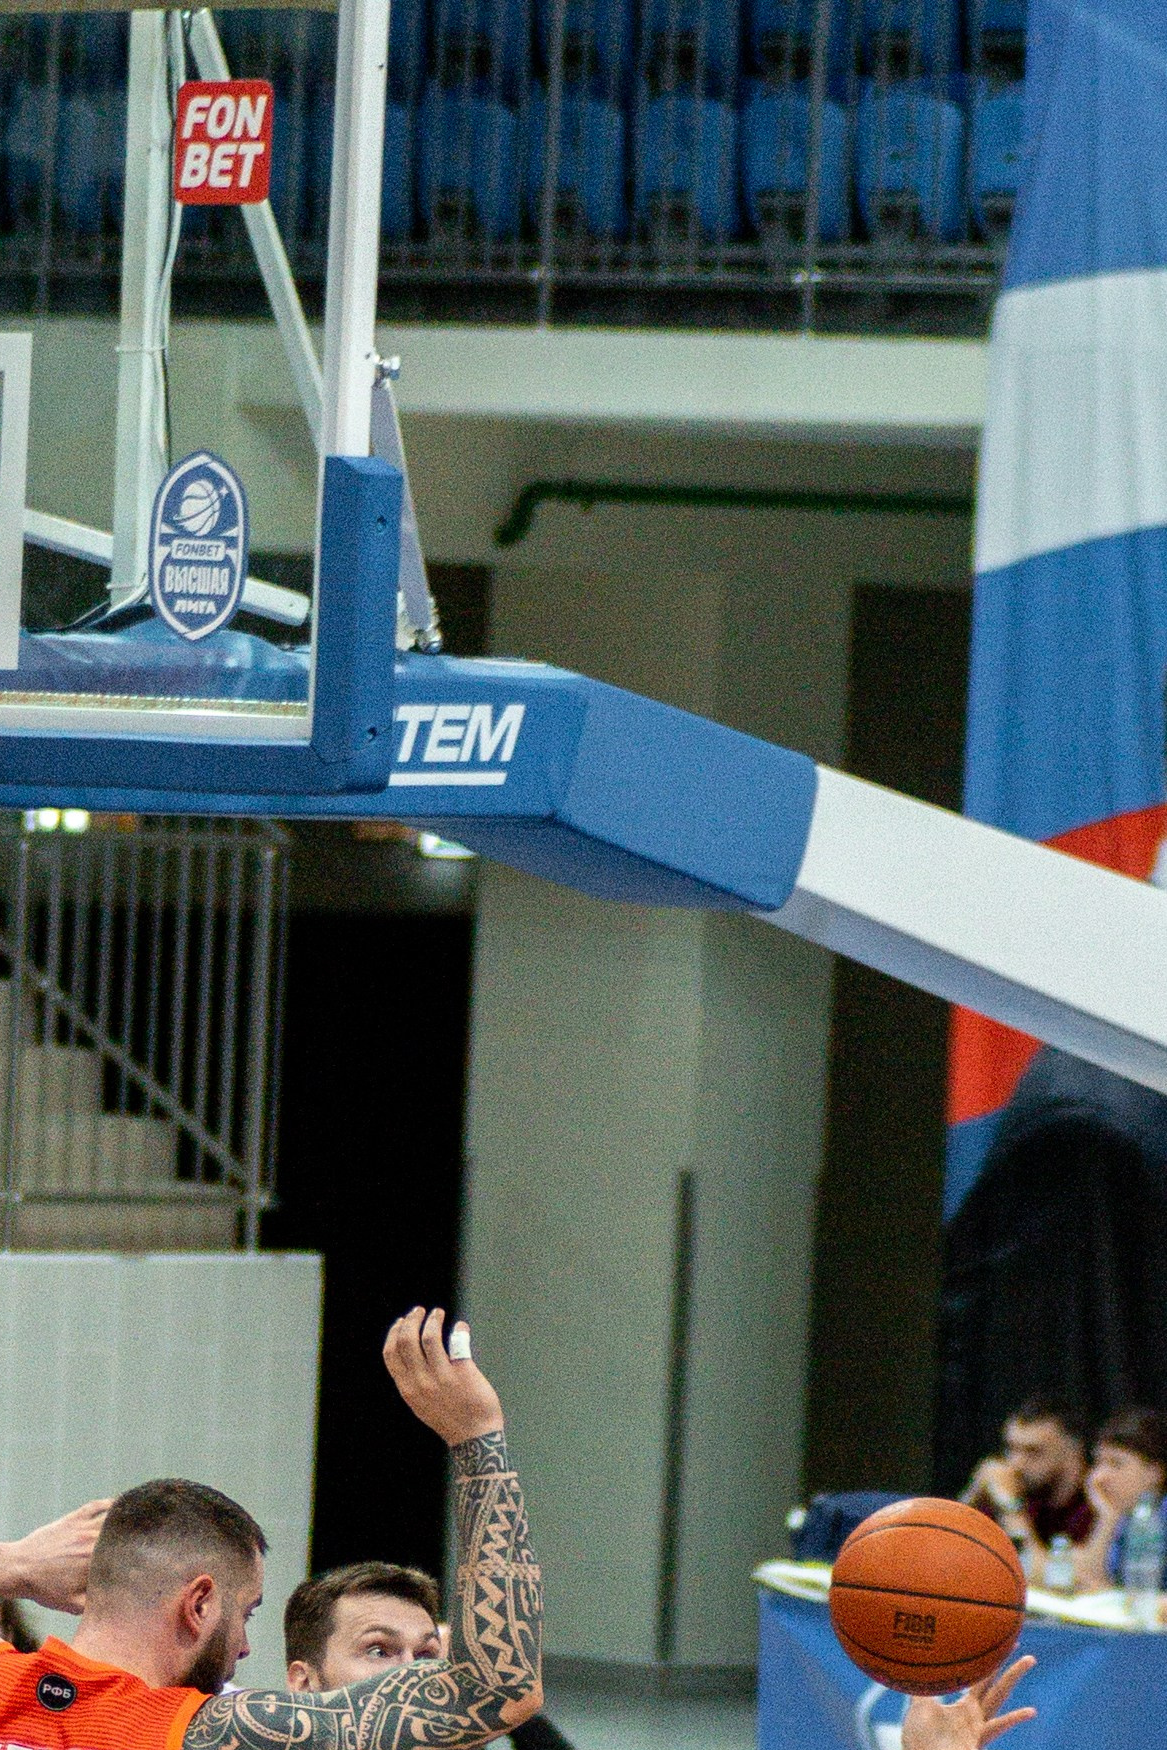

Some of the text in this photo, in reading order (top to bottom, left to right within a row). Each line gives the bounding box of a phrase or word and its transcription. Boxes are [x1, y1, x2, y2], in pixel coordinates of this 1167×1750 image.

[182, 95, 268, 139] FON
[179, 142, 266, 188] BET
[175, 542, 221, 556] FONBET
[164, 565, 230, 596] ВЫСШАЯ
[393, 704, 526, 763] TEM
[42, 1683, 72, 1699] РФБ
